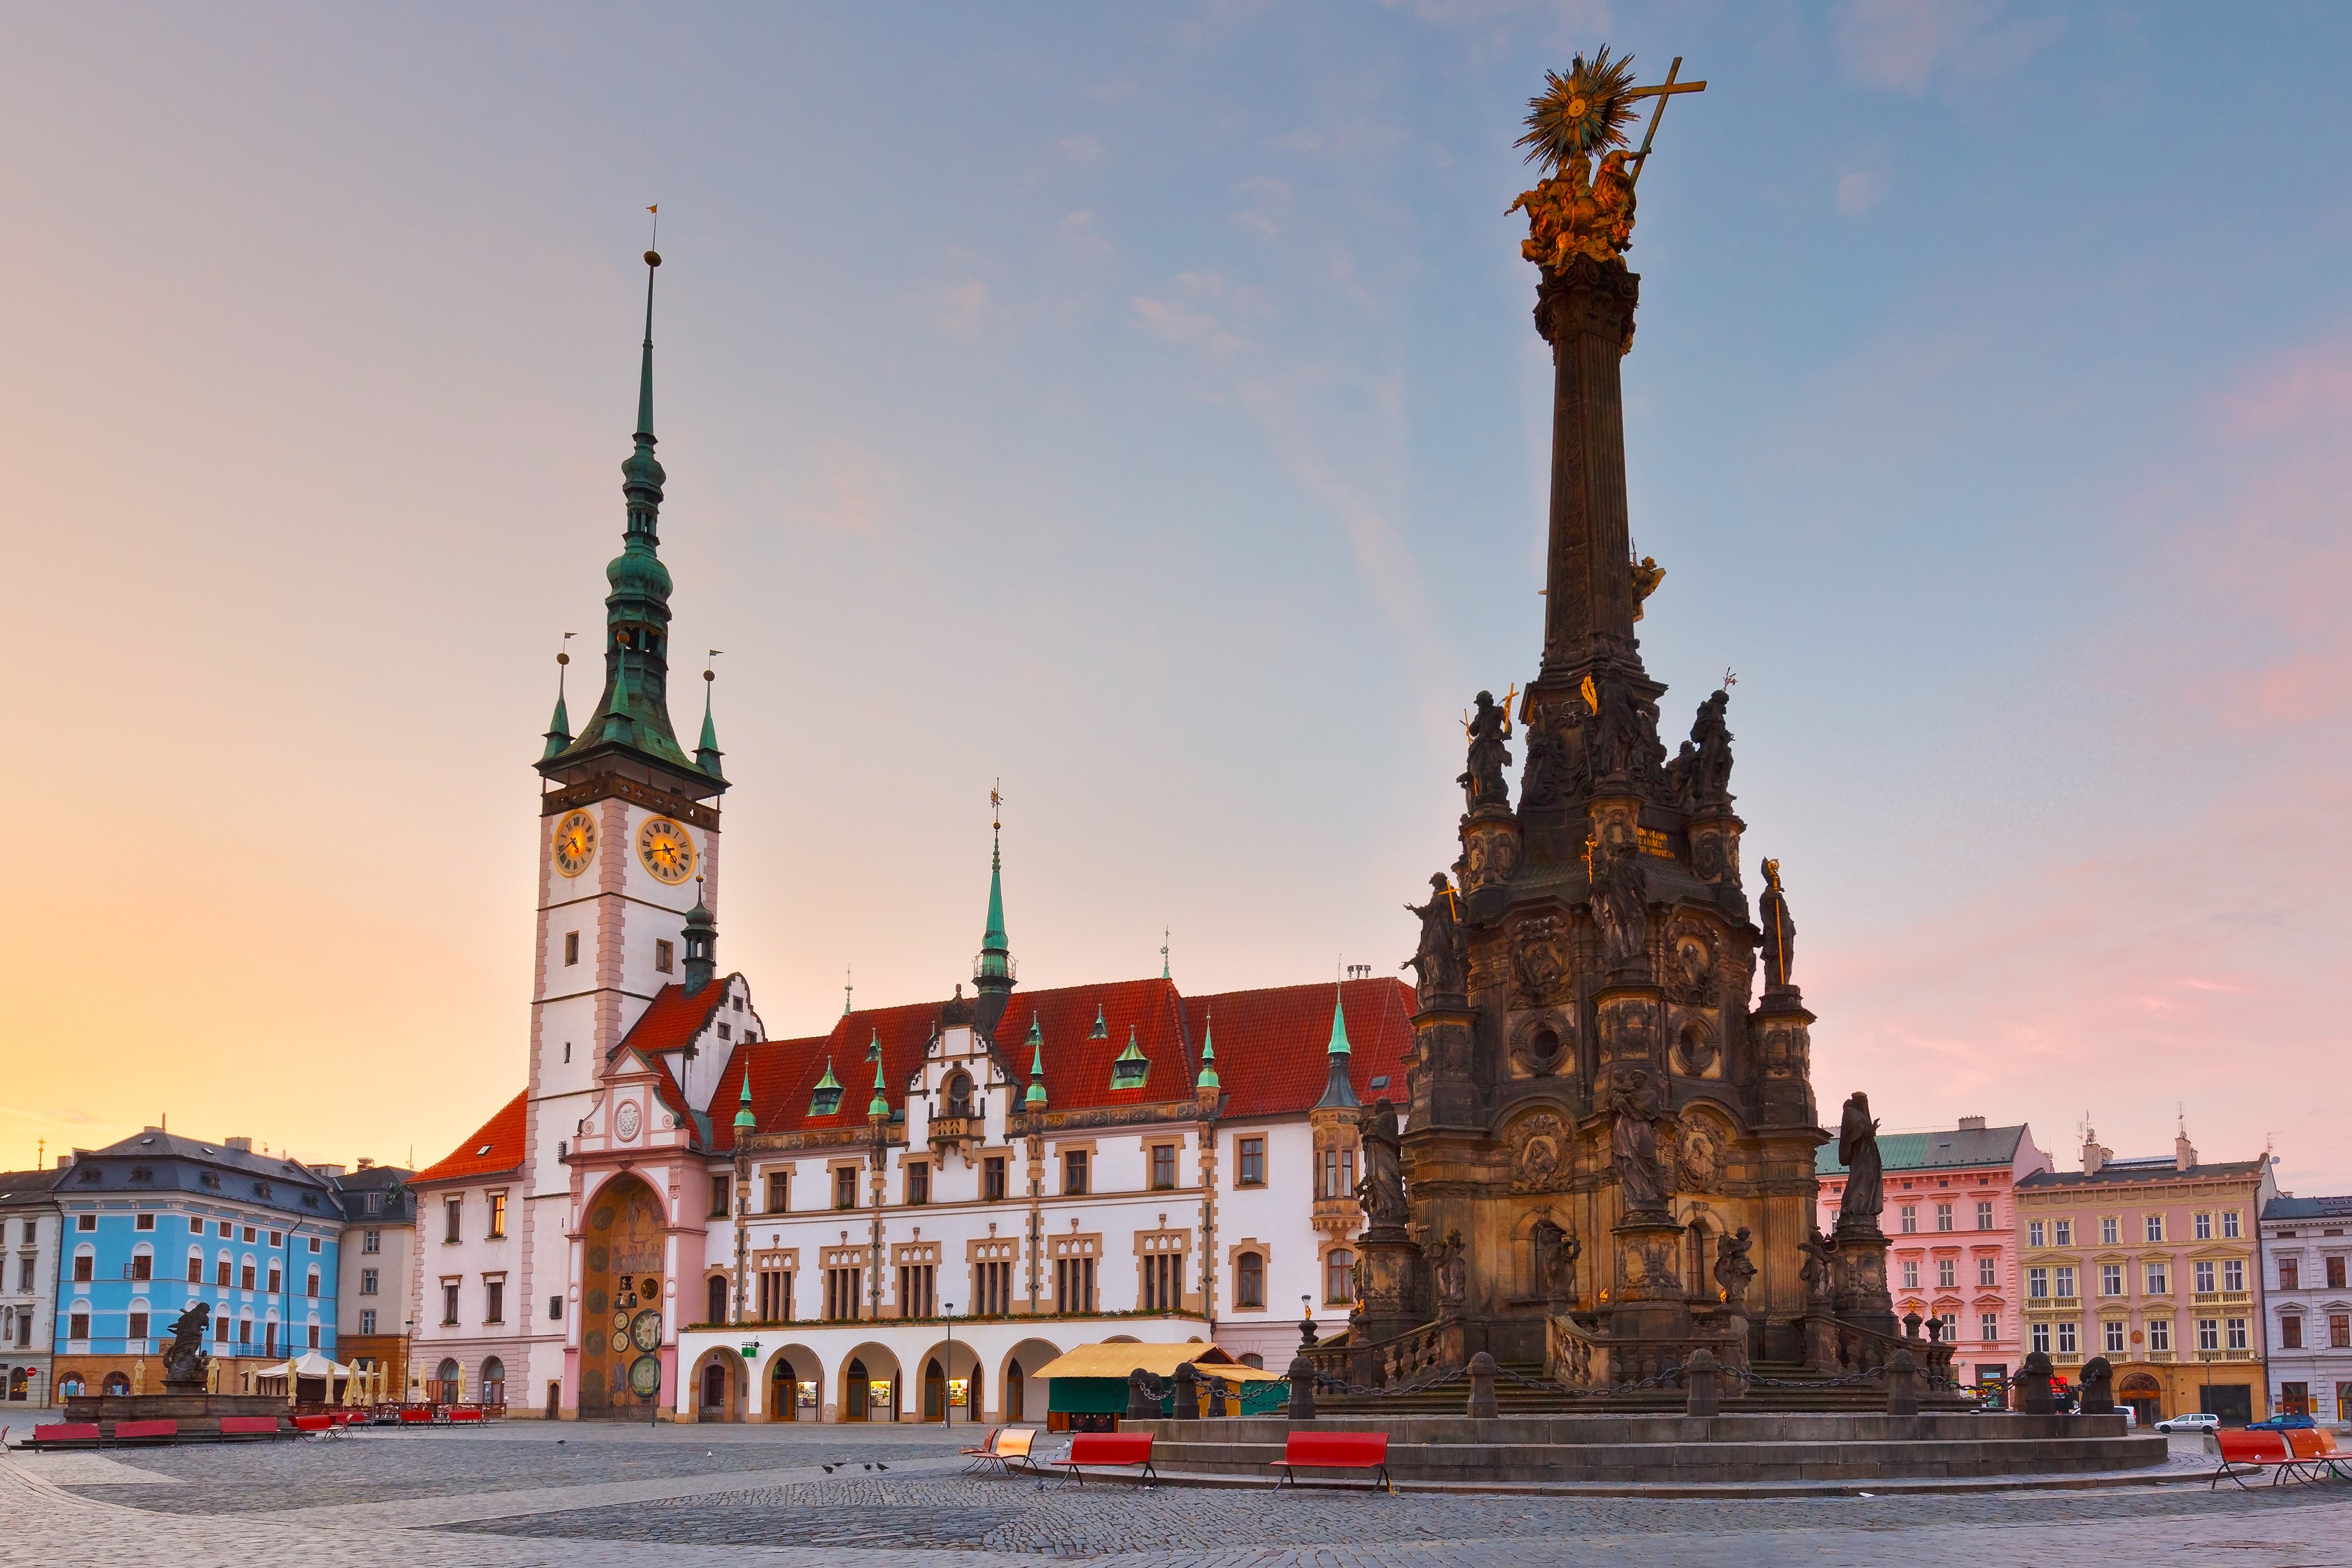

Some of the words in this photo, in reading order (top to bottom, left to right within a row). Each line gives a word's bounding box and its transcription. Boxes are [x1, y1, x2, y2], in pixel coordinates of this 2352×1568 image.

[645, 829, 654, 838] X
[663, 823, 671, 834] XII
[673, 867, 678, 877] V
